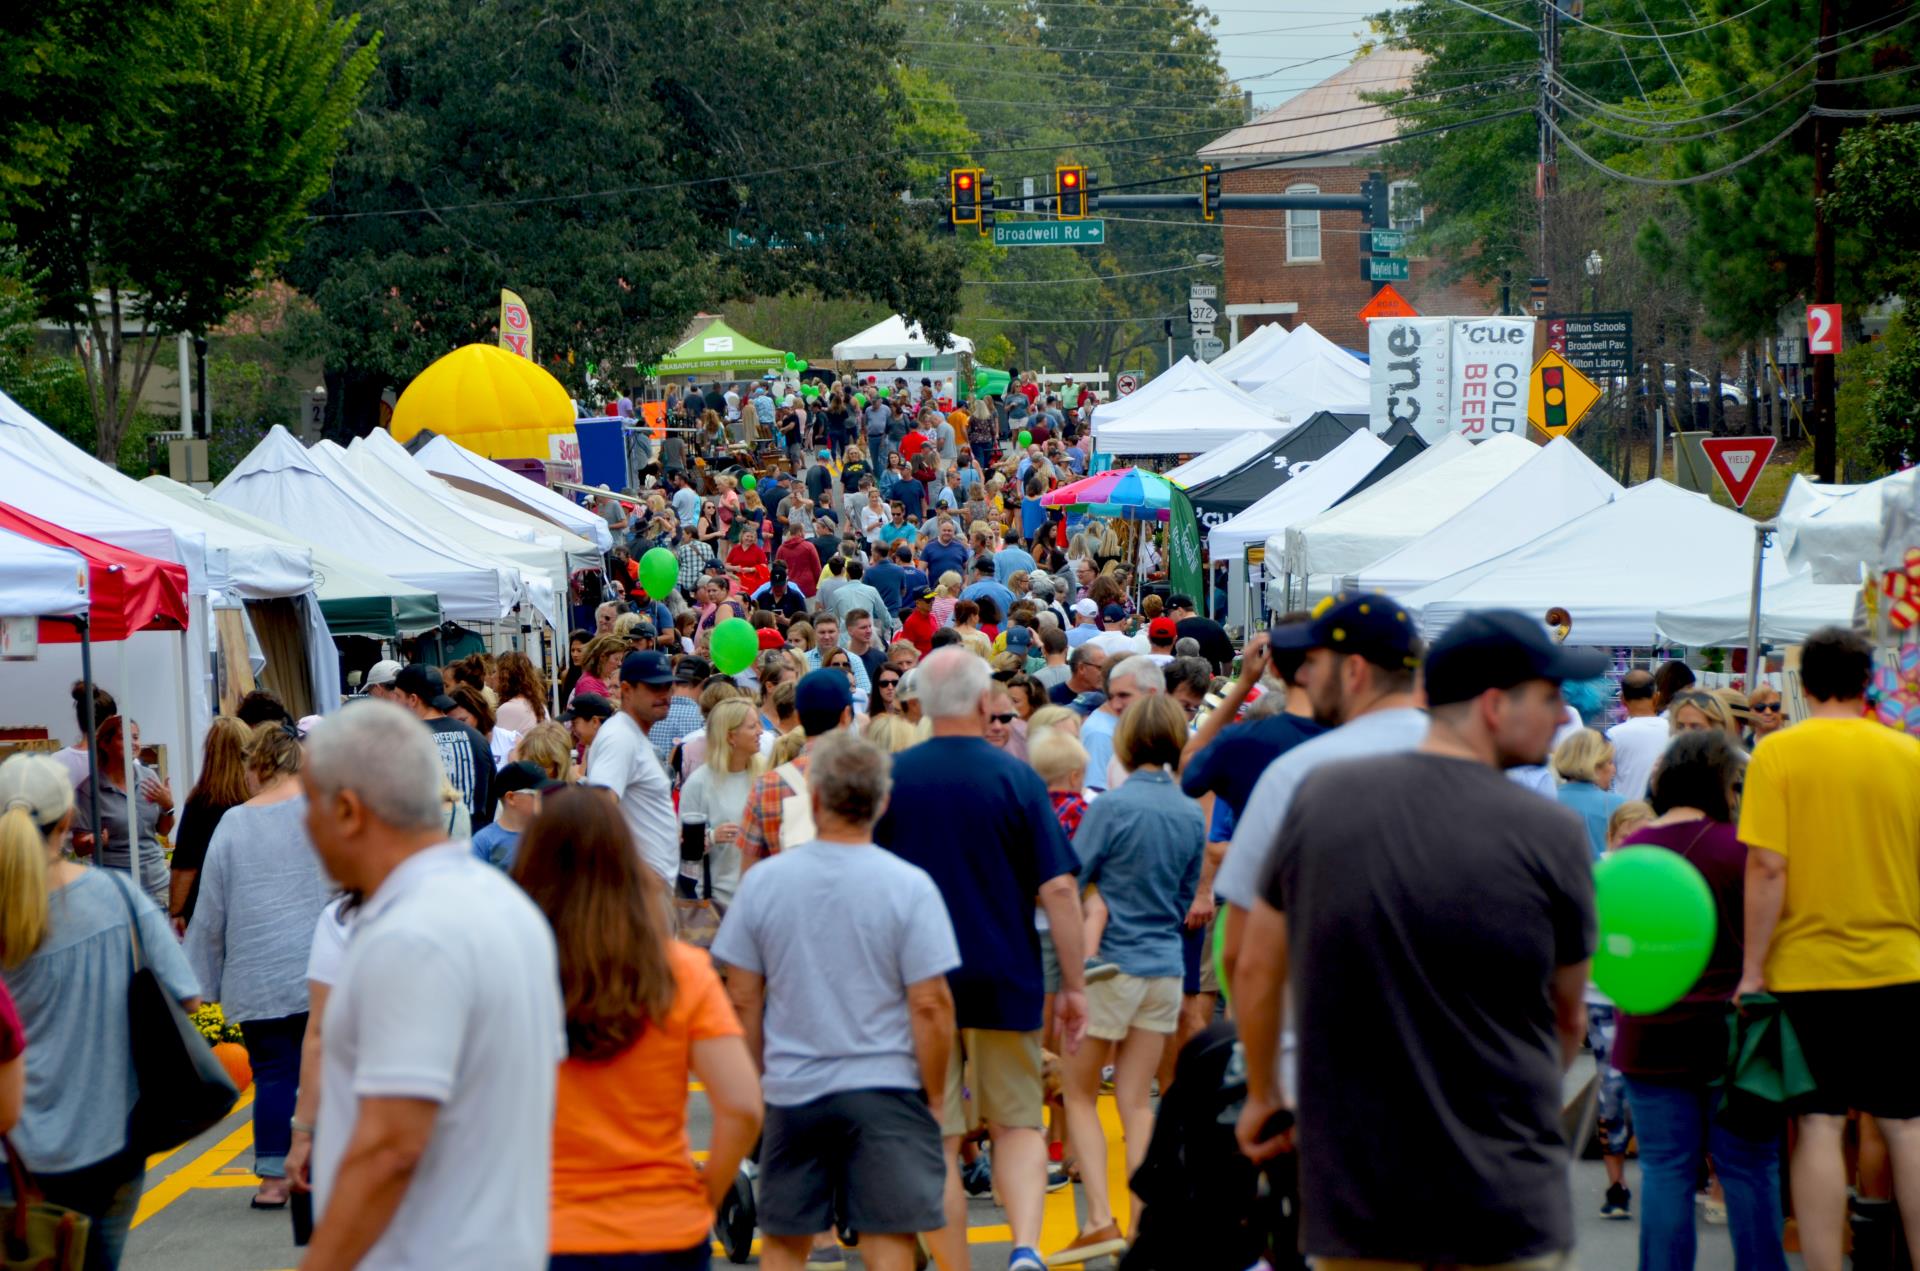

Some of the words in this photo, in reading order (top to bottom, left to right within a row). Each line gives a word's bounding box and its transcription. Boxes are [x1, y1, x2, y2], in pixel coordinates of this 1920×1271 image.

[997, 226, 1058, 241] Broadwell
[1065, 226, 1080, 240] Rd
[1192, 286, 1216, 297] NORTH
[1193, 307, 1213, 319] 372
[1566, 323, 1592, 333] Milton
[1593, 322, 1626, 332] Schools
[1810, 308, 1833, 352] 2
[1462, 323, 1525, 345] 'cue
[1568, 340, 1607, 350] Broadwell
[1609, 340, 1626, 349] Pav.
[658, 362, 698, 371] CRABAPPLE
[700, 360, 718, 368] FIRST
[720, 359, 748, 367] BAPTIST
[1595, 358, 1625, 368] Library
[1435, 326, 1446, 425] BARBECUE
[1461, 363, 1488, 436] BEER
[1491, 363, 1519, 433] COLD
[1726, 454, 1751, 465] YIELD
